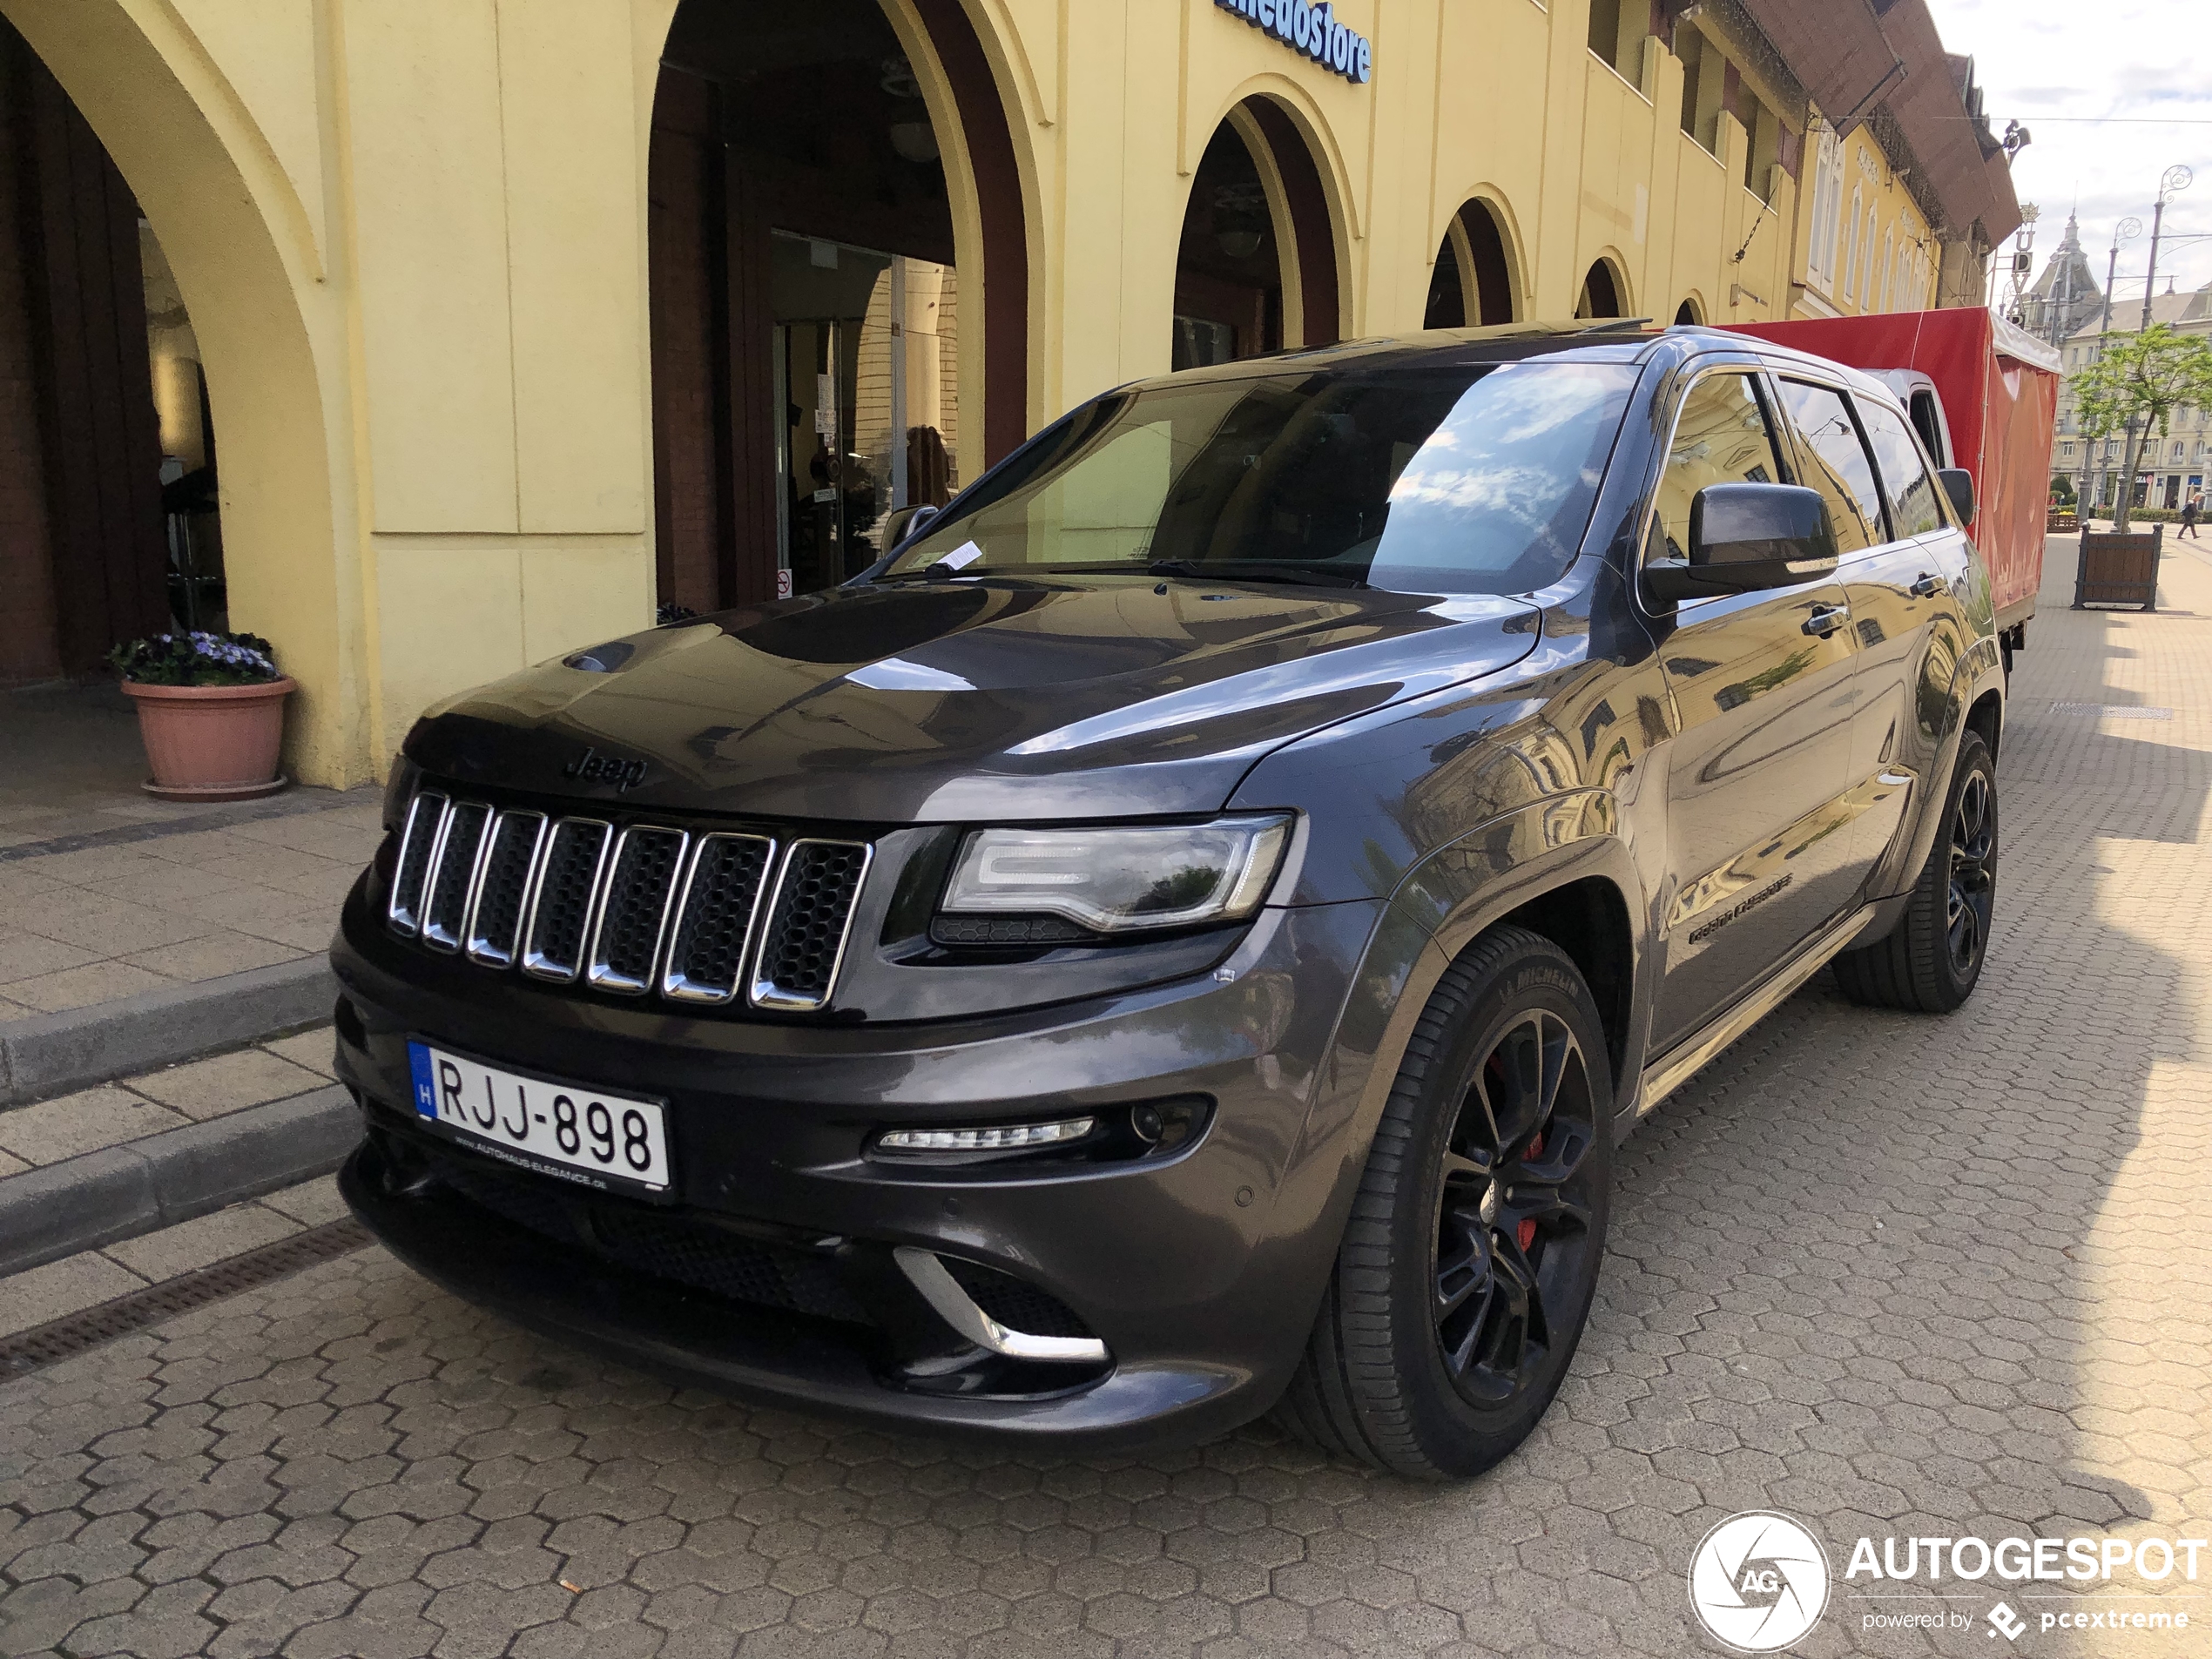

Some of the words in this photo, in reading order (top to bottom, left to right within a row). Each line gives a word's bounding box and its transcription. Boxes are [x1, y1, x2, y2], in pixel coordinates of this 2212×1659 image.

[563, 746, 648, 793] Jeep
[419, 1083, 432, 1106] H
[438, 1058, 652, 1172] RJJ-898
